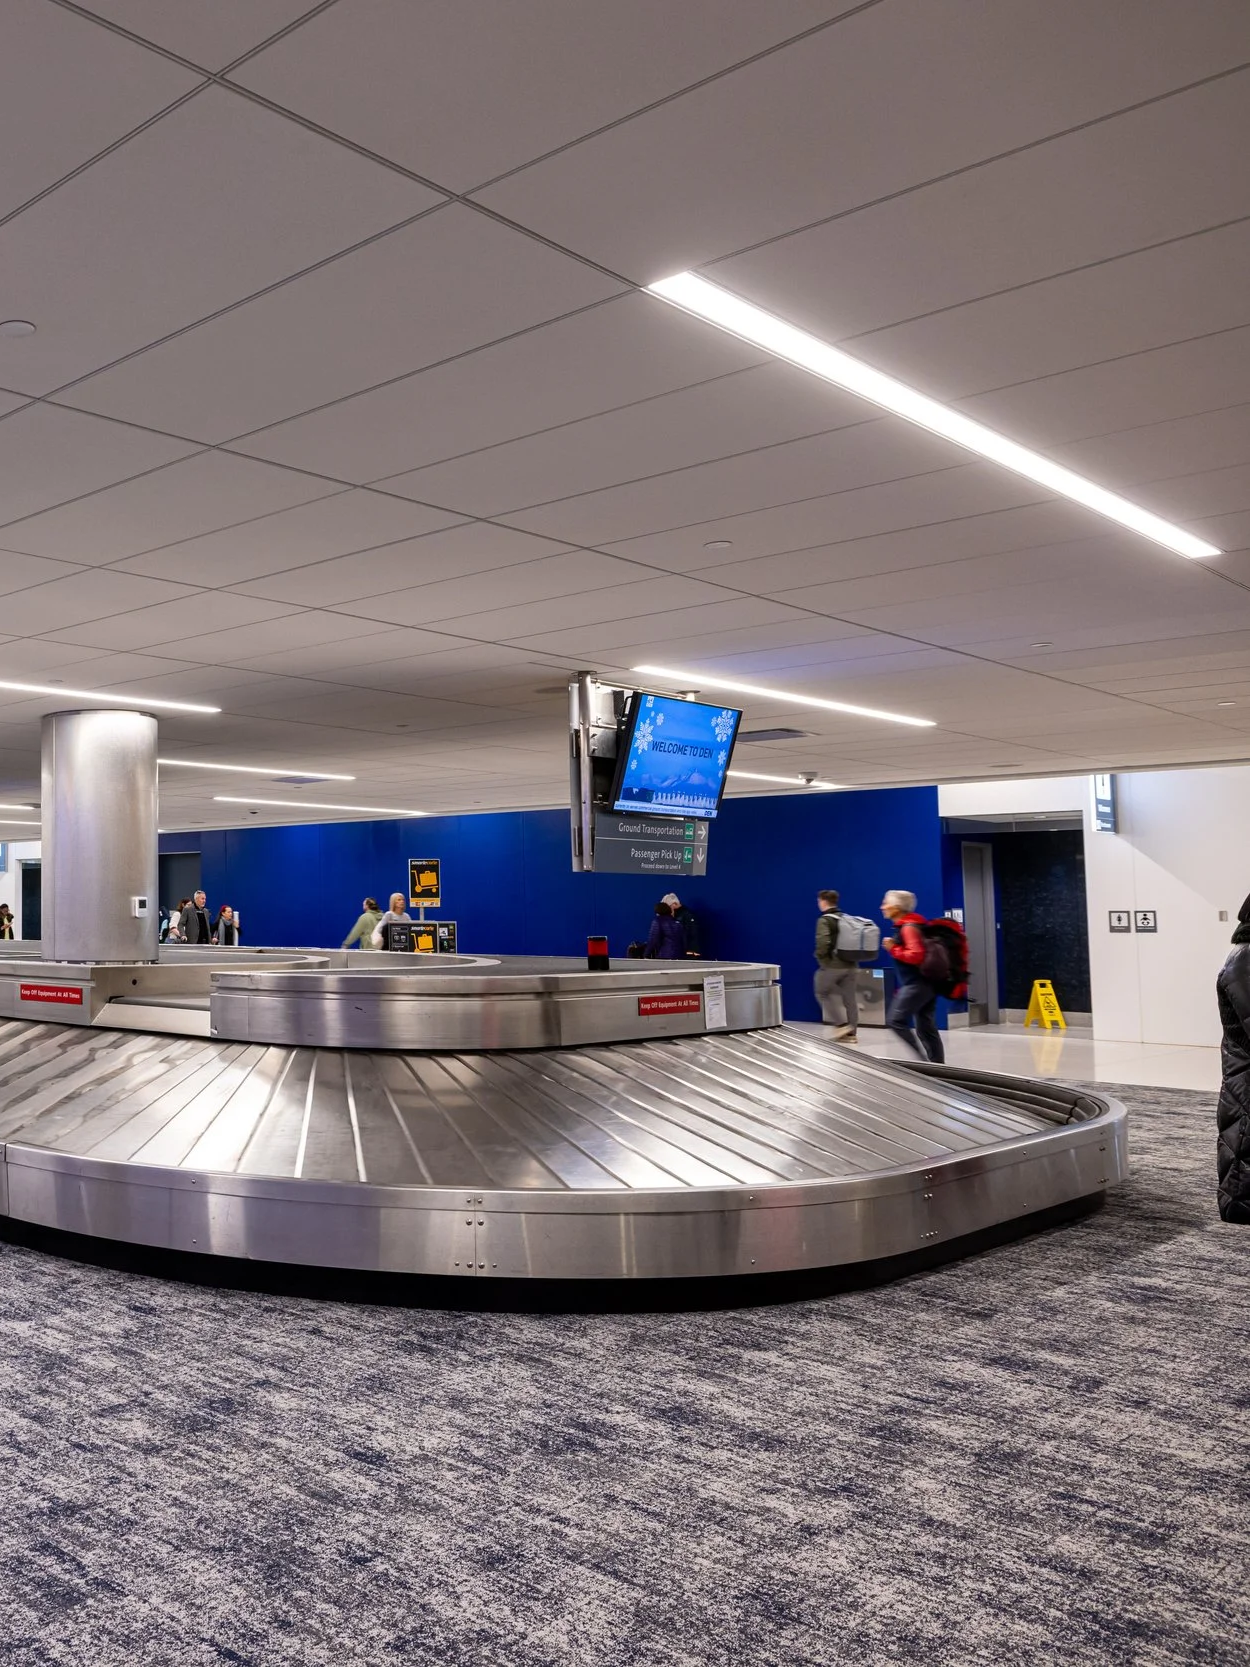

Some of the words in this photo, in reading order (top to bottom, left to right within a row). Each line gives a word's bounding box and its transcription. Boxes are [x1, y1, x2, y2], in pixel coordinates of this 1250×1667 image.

[652, 740, 688, 756] WELCOME
[690, 746, 698, 757] TO
[699, 747, 714, 758] DEN
[618, 822, 640, 833] Ground
[642, 824, 684, 836] Transportation
[630, 848, 660, 861] Passenger
[661, 850, 672, 859] Pick
[674, 851, 682, 861] Up
